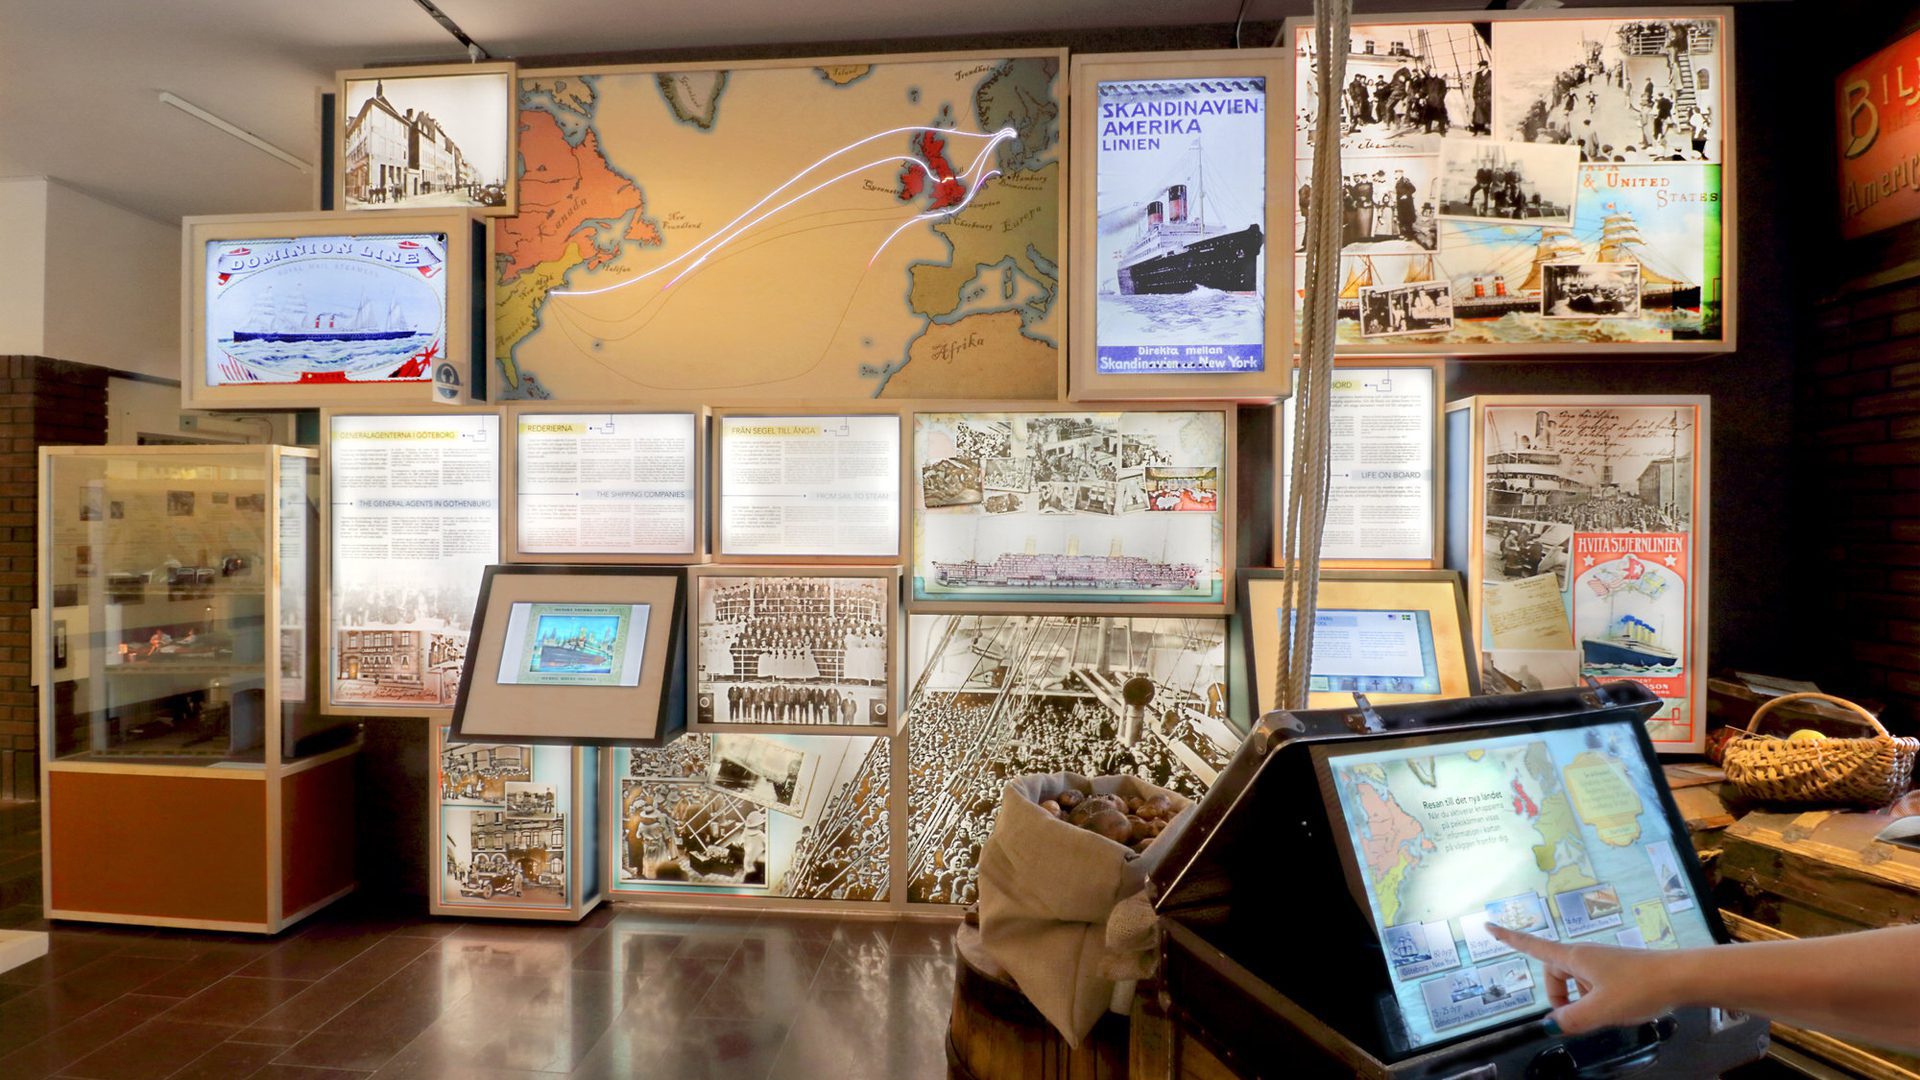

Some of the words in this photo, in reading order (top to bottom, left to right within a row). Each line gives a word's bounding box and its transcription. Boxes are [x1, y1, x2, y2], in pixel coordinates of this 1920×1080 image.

[1103, 119, 1202, 136] AMERIKA
[1102, 138, 1160, 151] LINIEN
[1583, 174, 1598, 193] &
[1001, 206, 1042, 233] Europa
[231, 243, 353, 270] DOMINION
[361, 244, 421, 264] LINE
[931, 333, 985, 364] Afrika
[1138, 346, 1180, 355] Direkta
[1186, 346, 1223, 355] mellan
[1228, 355, 1258, 368] York
[731, 426, 752, 435] FRÅN
[359, 500, 373, 508] THE
[373, 500, 405, 508] GENERAL
[406, 500, 433, 508] AGENTS
[1422, 800, 1444, 809] Resan
[1455, 796, 1467, 804] det
